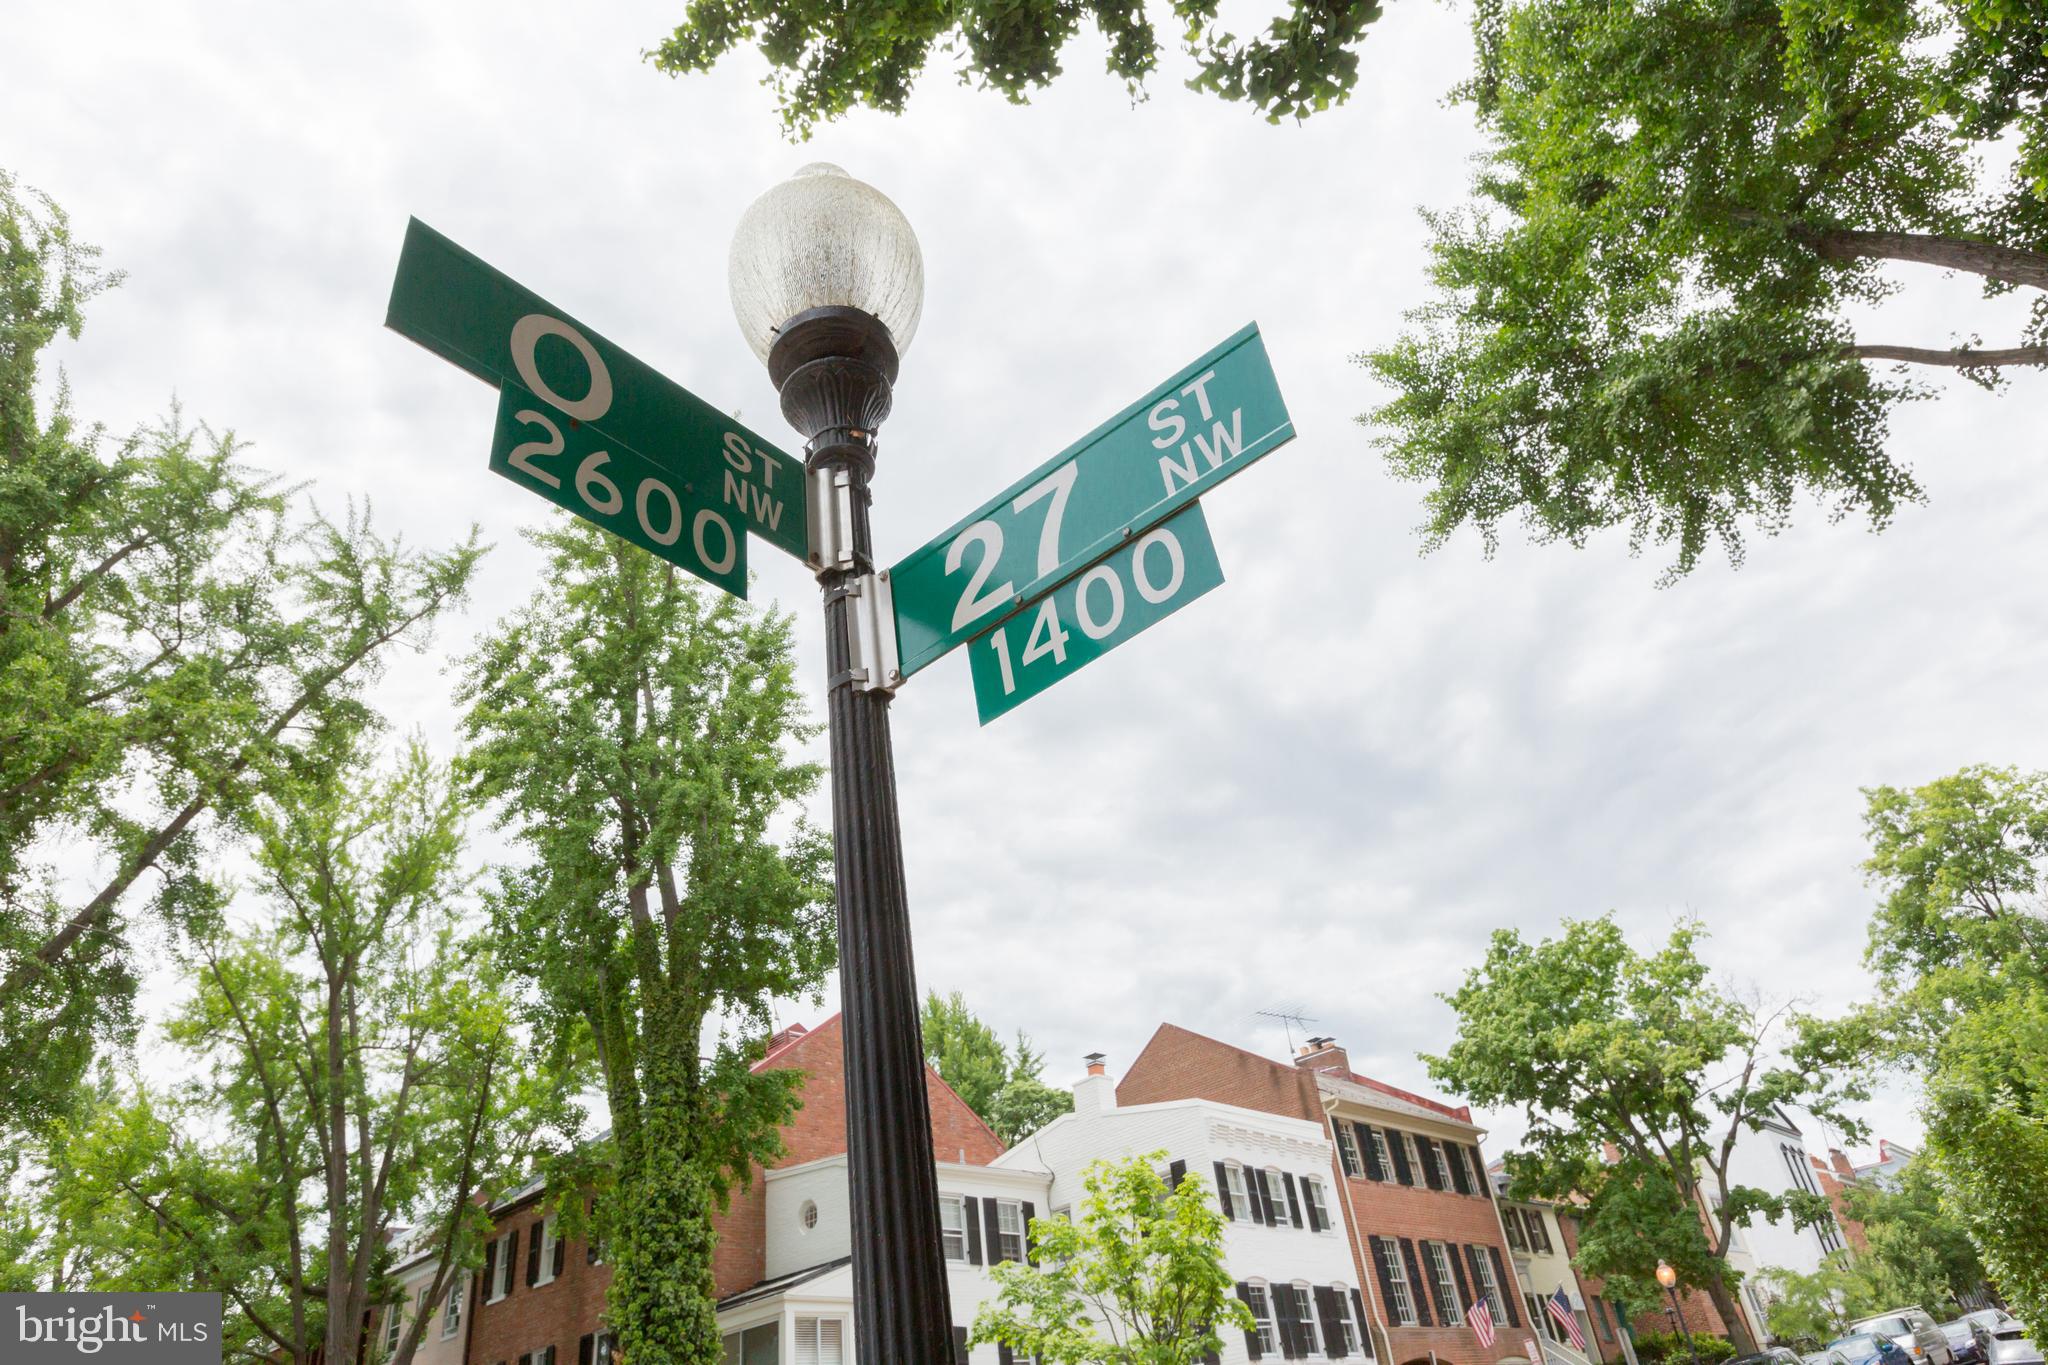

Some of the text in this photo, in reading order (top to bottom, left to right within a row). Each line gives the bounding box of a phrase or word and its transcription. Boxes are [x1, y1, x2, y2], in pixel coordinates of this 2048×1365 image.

[510, 314, 613, 421] O
[1147, 370, 1216, 449] ST
[507, 410, 736, 575] 2600
[723, 432, 782, 487] ST
[723, 470, 784, 531] NW
[1158, 407, 1242, 497] NW
[944, 459, 1078, 633] 27
[990, 528, 1185, 696] 1400
